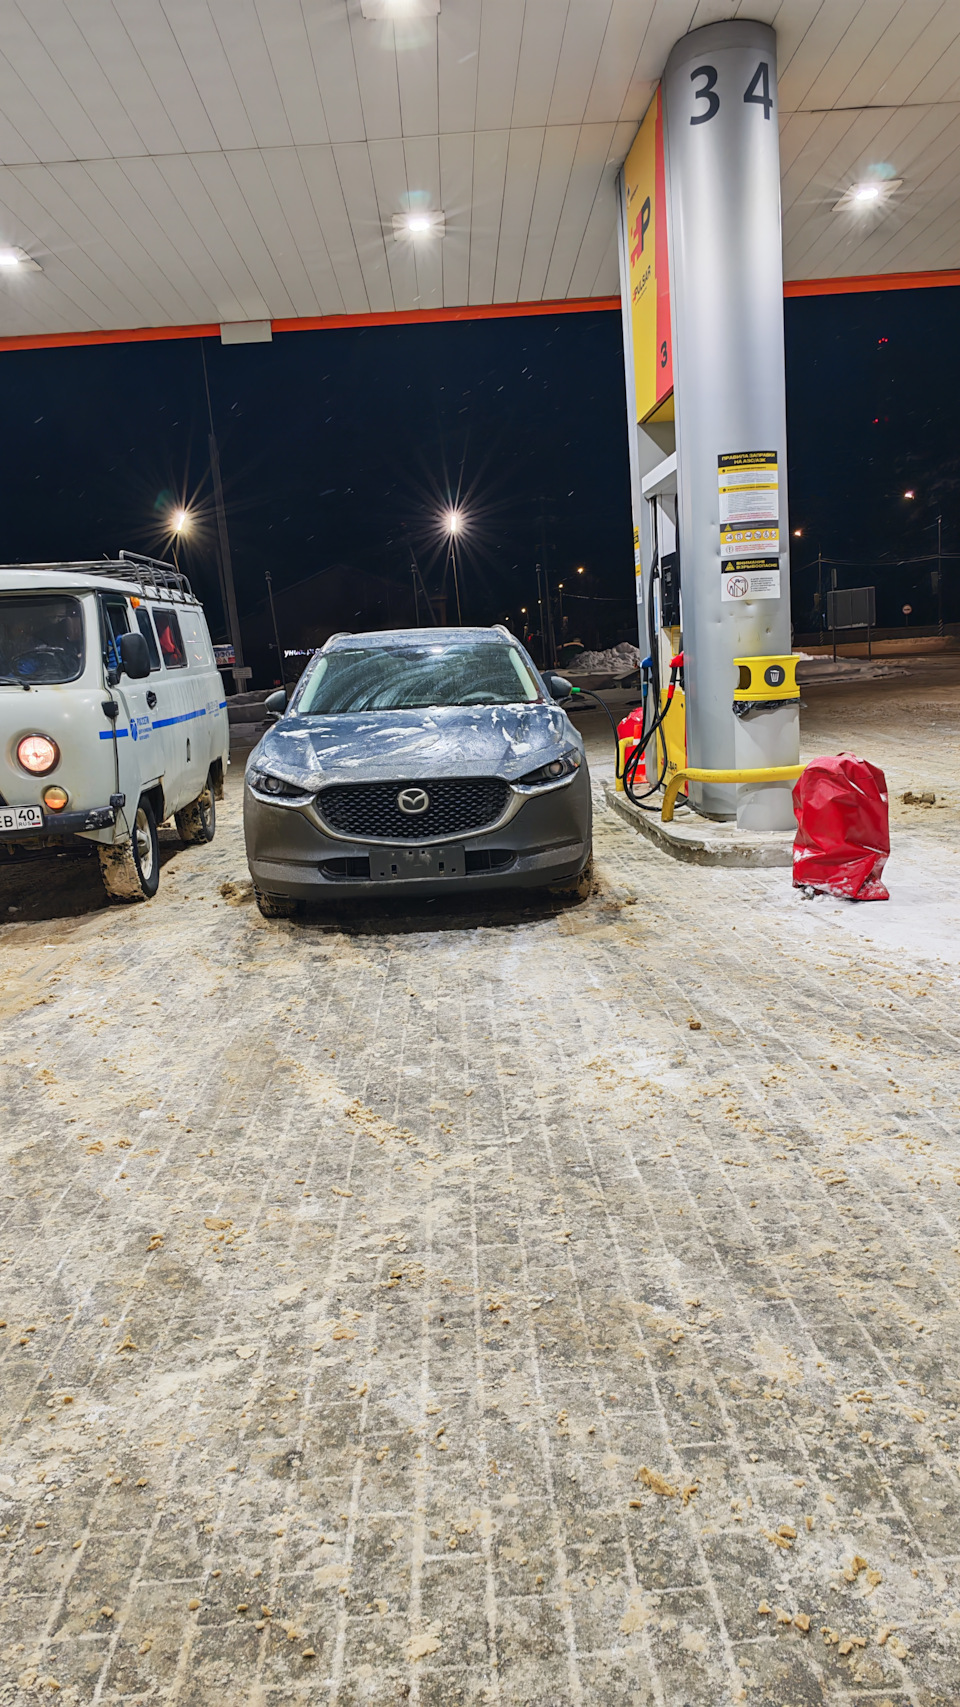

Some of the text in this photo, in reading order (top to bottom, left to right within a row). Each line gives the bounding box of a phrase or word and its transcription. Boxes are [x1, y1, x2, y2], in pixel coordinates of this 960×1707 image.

[690, 61, 773, 125] 3 4
[660, 340, 668, 368] 3
[721, 453, 748, 461] ПРАВИЛА
[18, 809, 36, 822] 40
